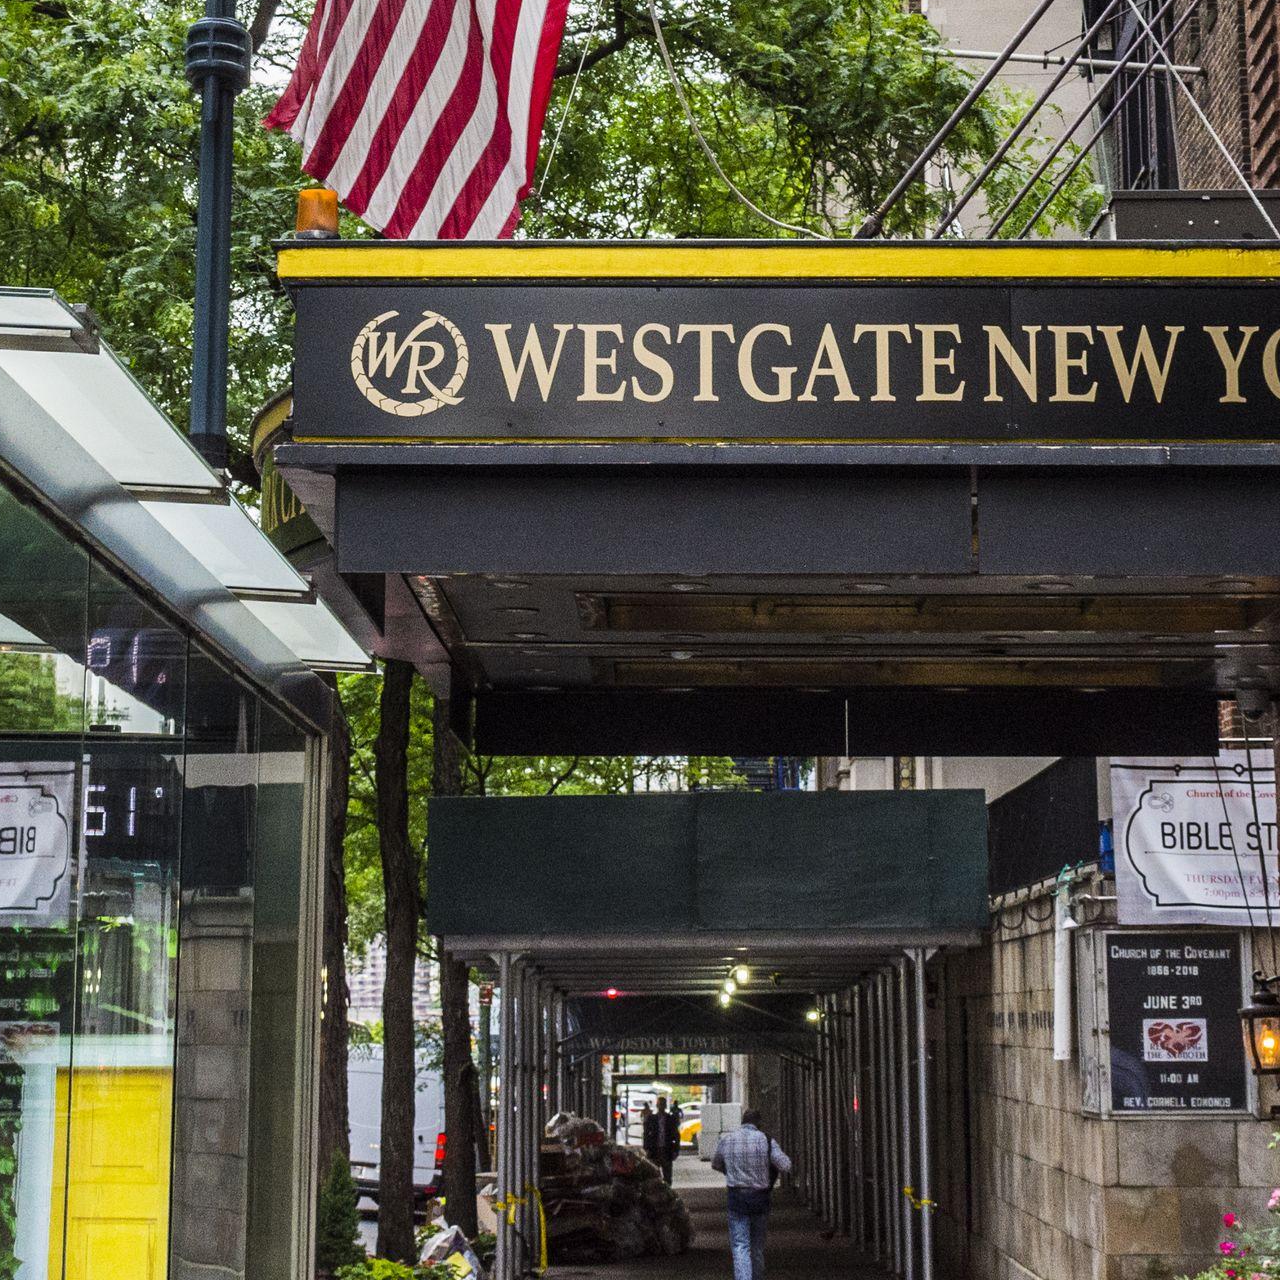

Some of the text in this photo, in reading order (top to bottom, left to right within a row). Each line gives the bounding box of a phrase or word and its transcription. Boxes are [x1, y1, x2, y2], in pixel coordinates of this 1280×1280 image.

[484, 322, 967, 403] WESTGATE
[983, 324, 1185, 404] NEW
[1161, 822, 1278, 850] BIBLE ST
[1143, 995, 1178, 1009] JUNE
[590, 1036, 673, 1051] WODSTOCK
